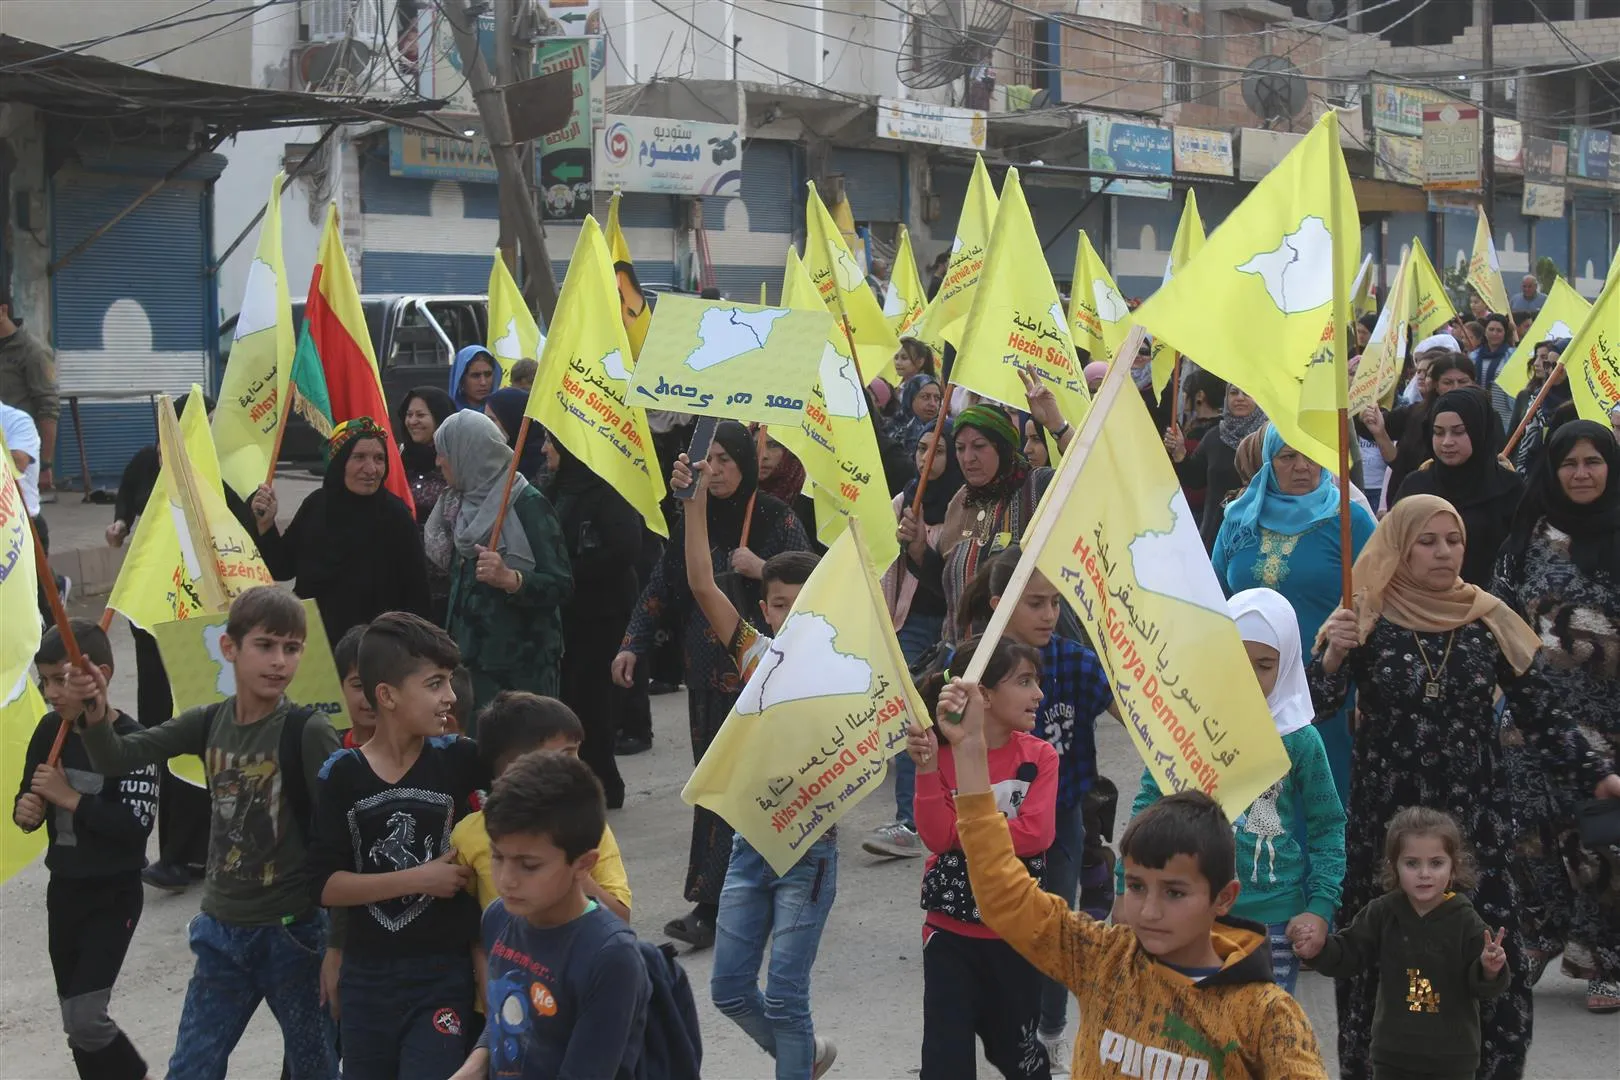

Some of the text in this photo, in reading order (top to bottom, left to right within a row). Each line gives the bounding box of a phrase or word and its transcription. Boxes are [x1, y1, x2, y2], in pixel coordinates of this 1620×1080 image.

[653, 124, 692, 142] ستوديو
[638, 139, 701, 168] معصوم
[1008, 331, 1044, 360] Hêzên
[585, 391, 621, 428] Sûriya
[841, 461, 872, 485] قوات
[1093, 521, 1240, 768] قوات سوريا الديمقراطية
[1072, 535, 1220, 797] Hêzên Sûriya Demokratîk
[533, 987, 554, 1009] Me
